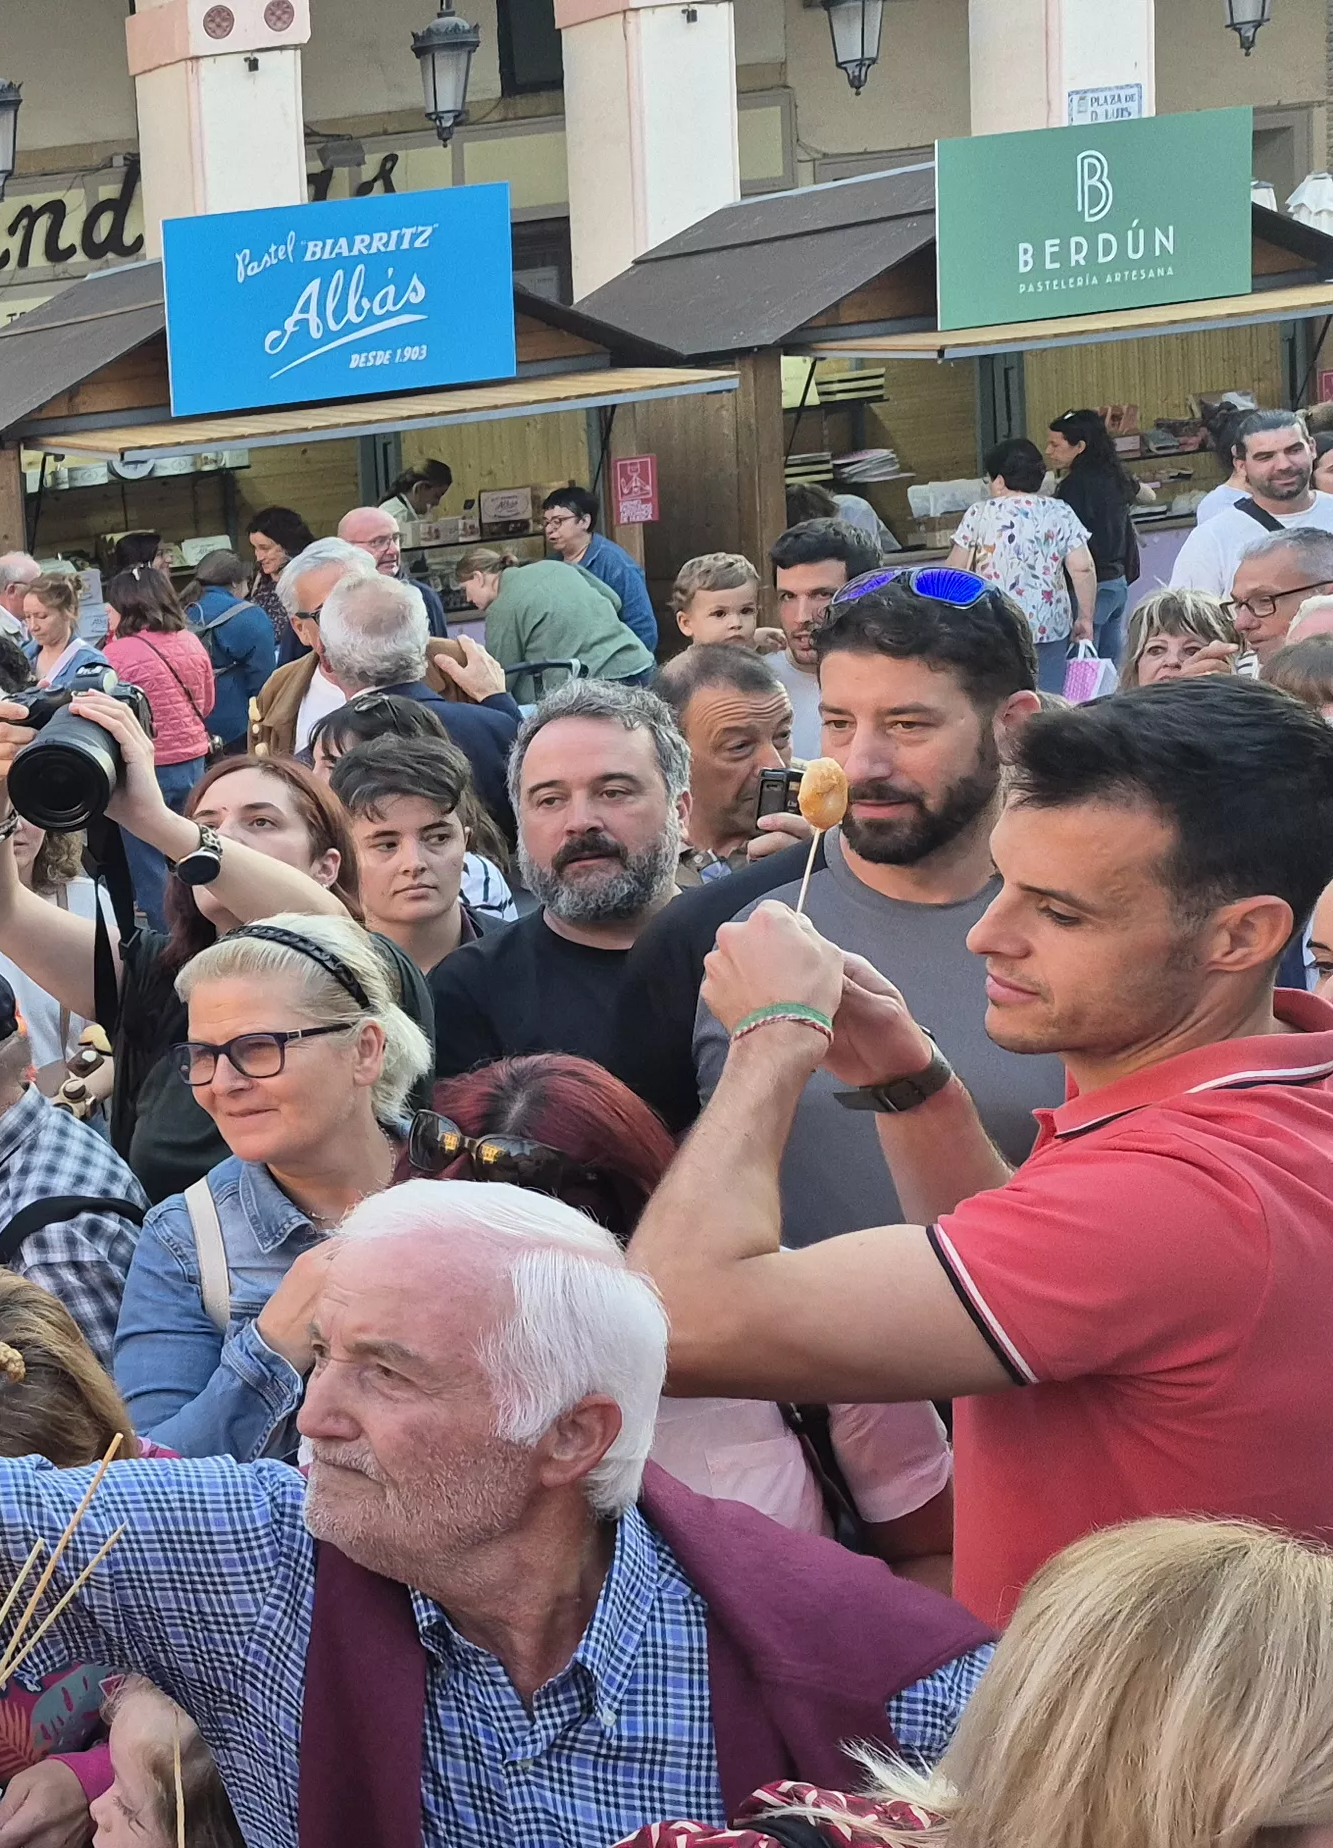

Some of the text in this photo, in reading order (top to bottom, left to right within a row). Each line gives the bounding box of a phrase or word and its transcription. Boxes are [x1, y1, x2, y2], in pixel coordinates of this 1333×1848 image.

[1090, 93, 1137, 108] PLAZA DE
[1076, 149, 1113, 223] B
[236, 230, 296, 283] Pastel
[1018, 218, 1174, 273] BERDÚN
[1019, 266, 1174, 294] PASTELERÍA ARTESANA
[264, 263, 427, 355] Albás
[349, 350, 392, 369] DESDE
